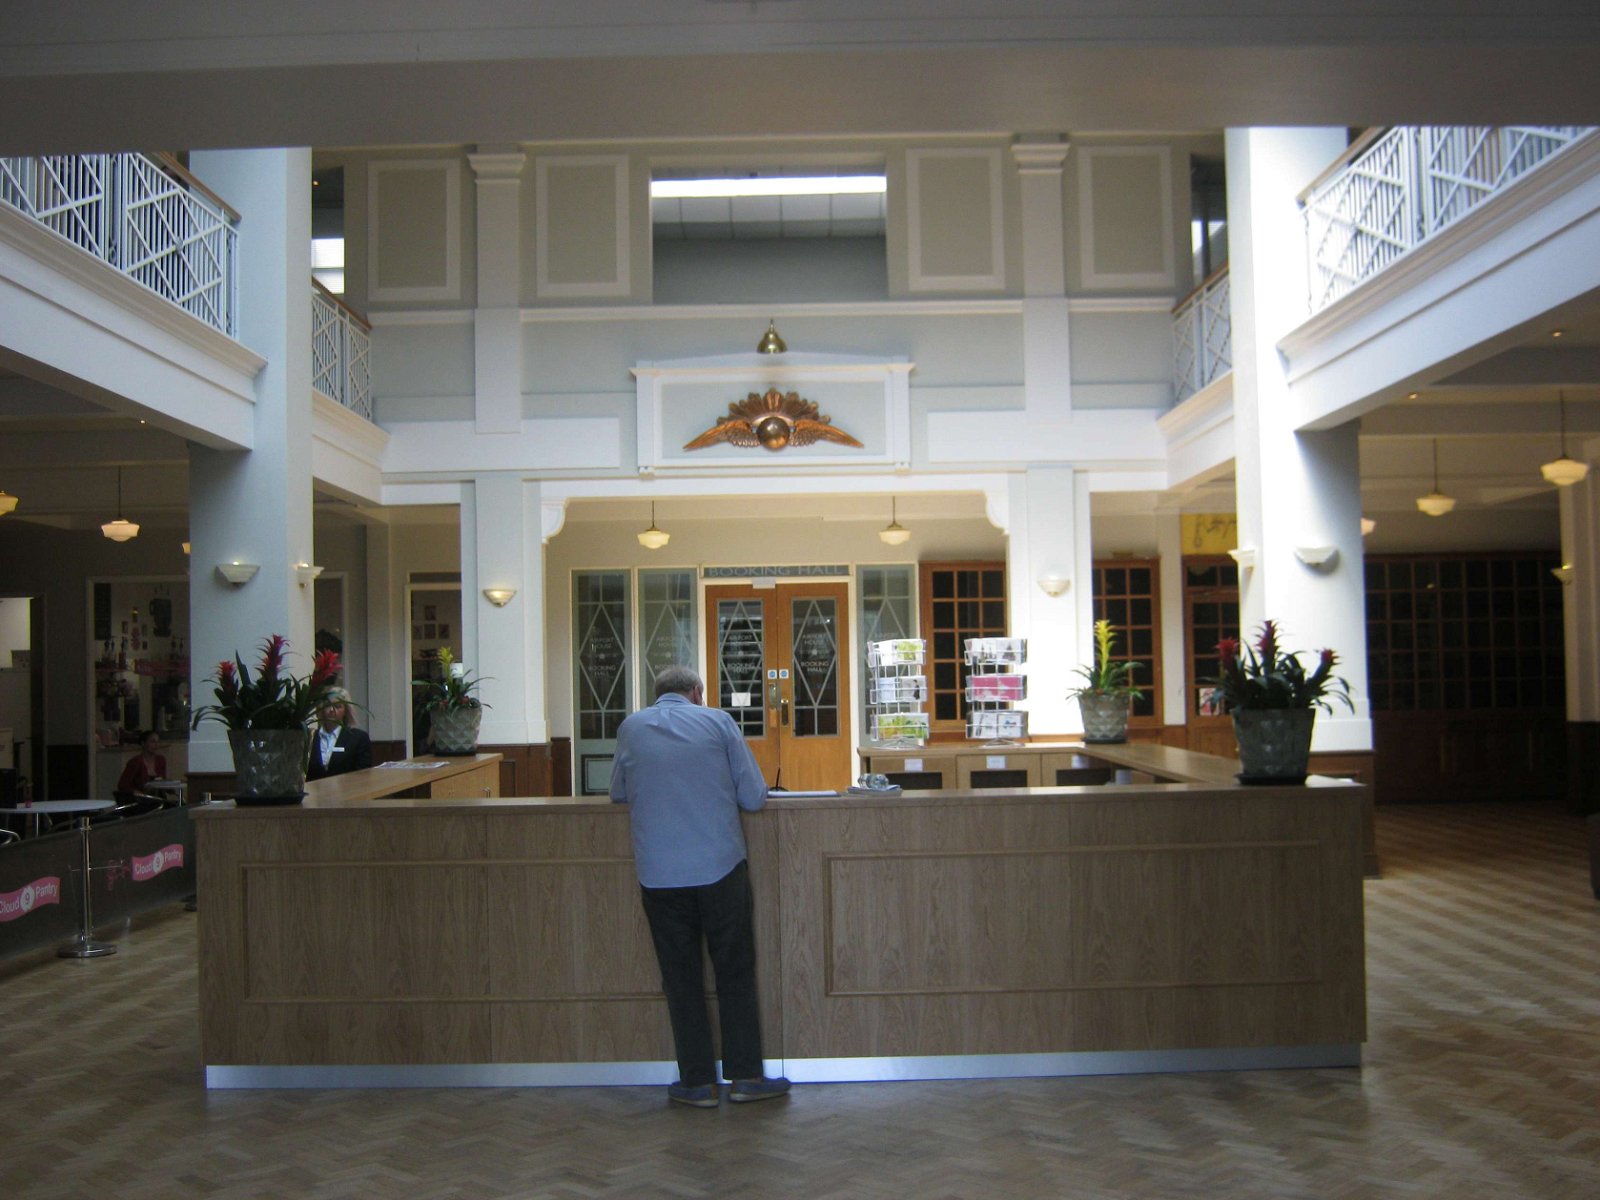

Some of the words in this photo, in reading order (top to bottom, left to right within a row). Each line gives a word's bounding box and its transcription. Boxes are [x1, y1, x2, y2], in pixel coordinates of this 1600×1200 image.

[709, 566, 791, 577] BOOKING
[798, 565, 842, 576] HALL
[134, 863, 154, 874] Cloud
[164, 849, 182, 863] Pantry
[35, 882, 58, 900] Pantry
